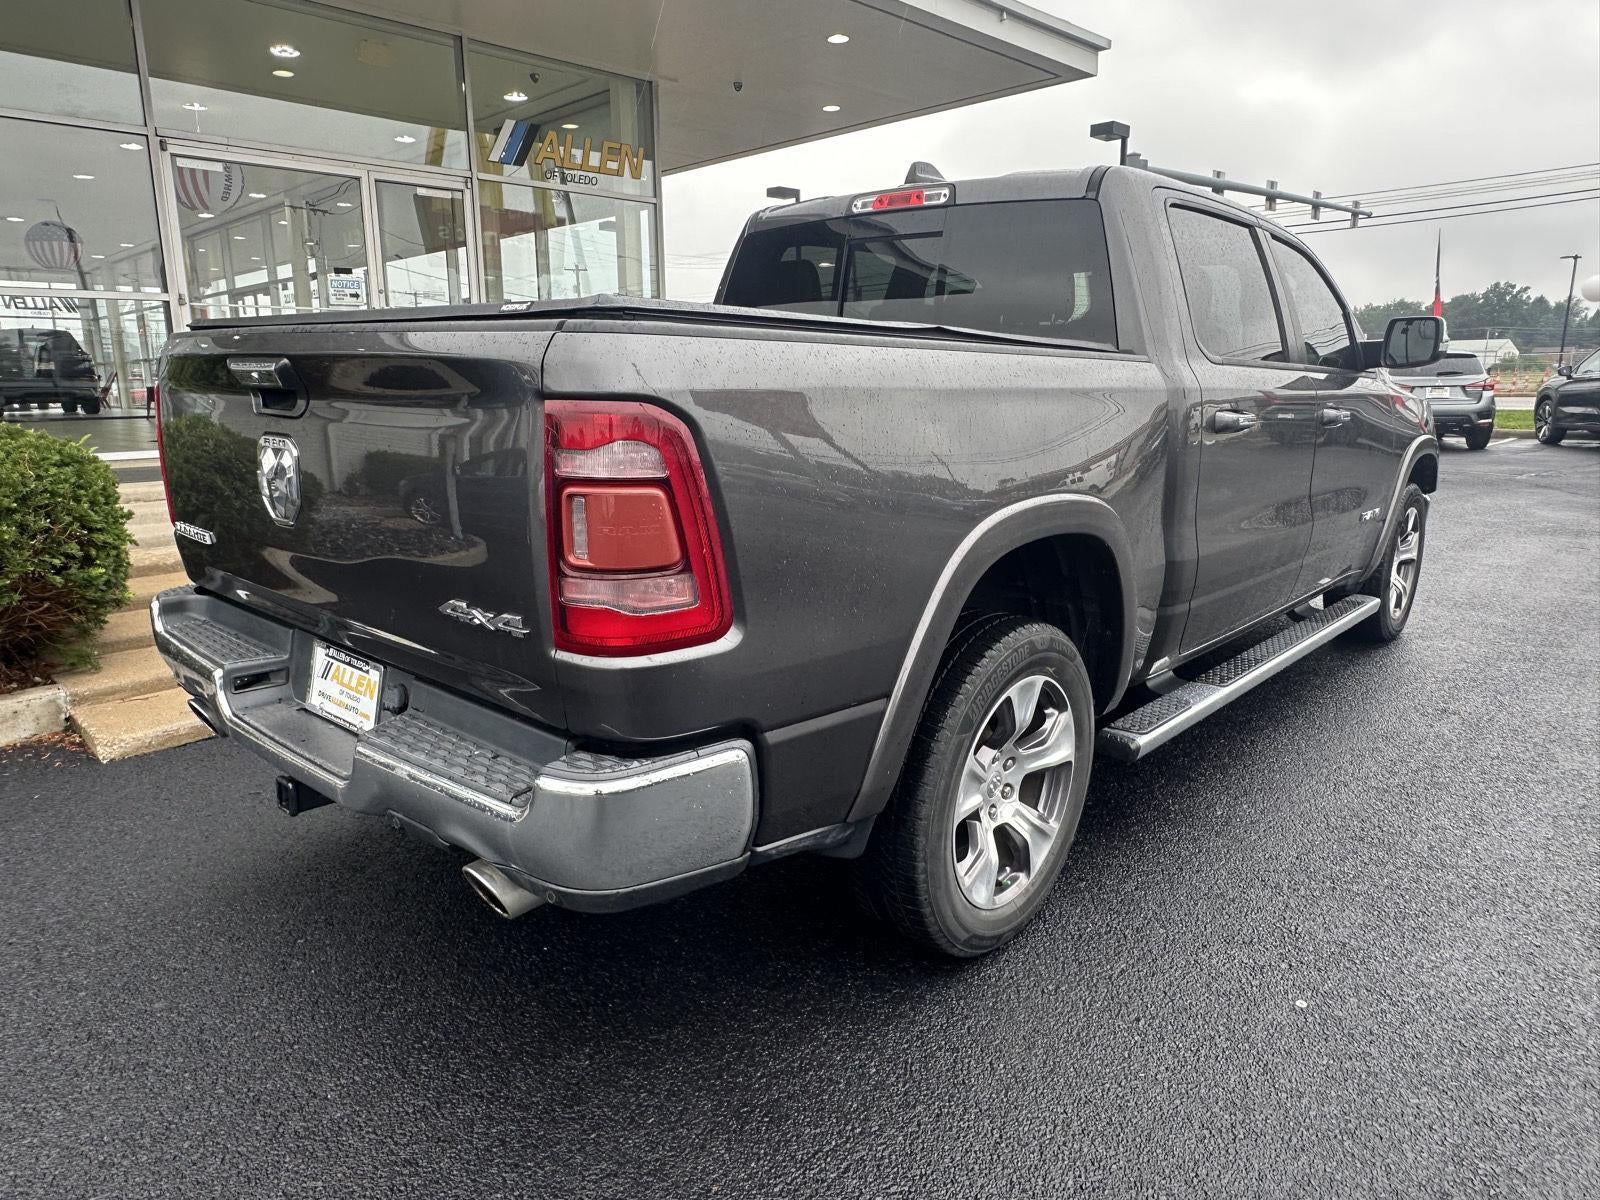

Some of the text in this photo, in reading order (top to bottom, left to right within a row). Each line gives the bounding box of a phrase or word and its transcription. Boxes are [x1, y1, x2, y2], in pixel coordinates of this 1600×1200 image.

[535, 130, 644, 180] ALLEN
[544, 169, 598, 186] OF TOLEDO
[331, 280, 360, 289] NOTICE
[330, 664, 378, 701] ALLEN
